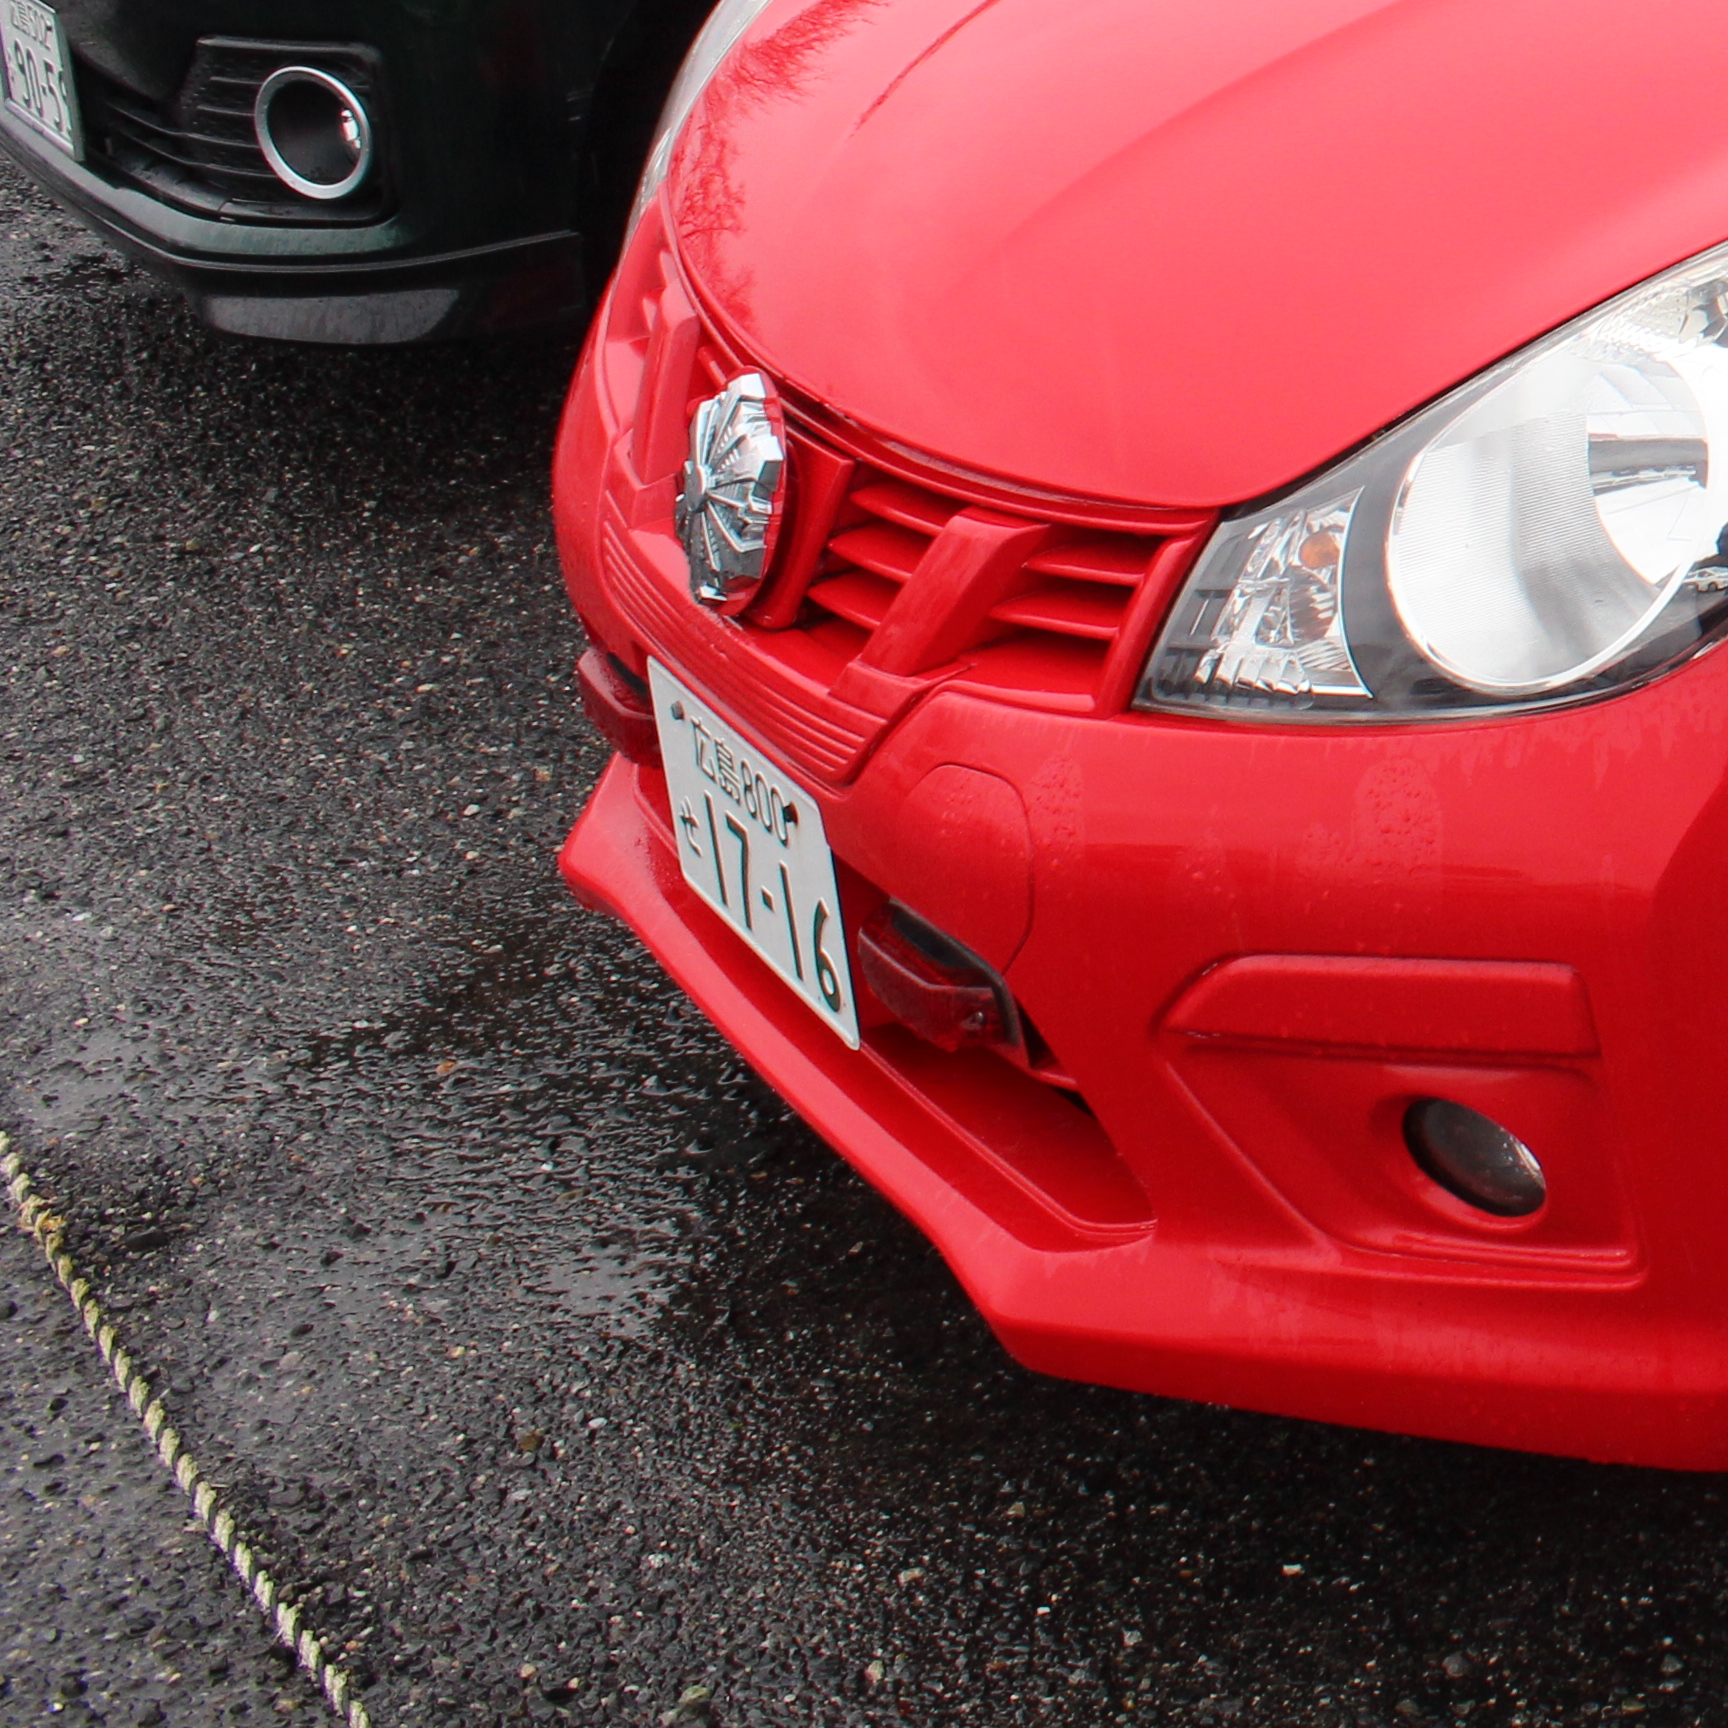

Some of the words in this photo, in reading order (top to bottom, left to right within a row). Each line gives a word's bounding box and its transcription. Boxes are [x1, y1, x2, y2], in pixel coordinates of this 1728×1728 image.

[689, 715, 791, 849] 広島800
[679, 795, 704, 858] せ
[704, 788, 843, 1014] 17-16
